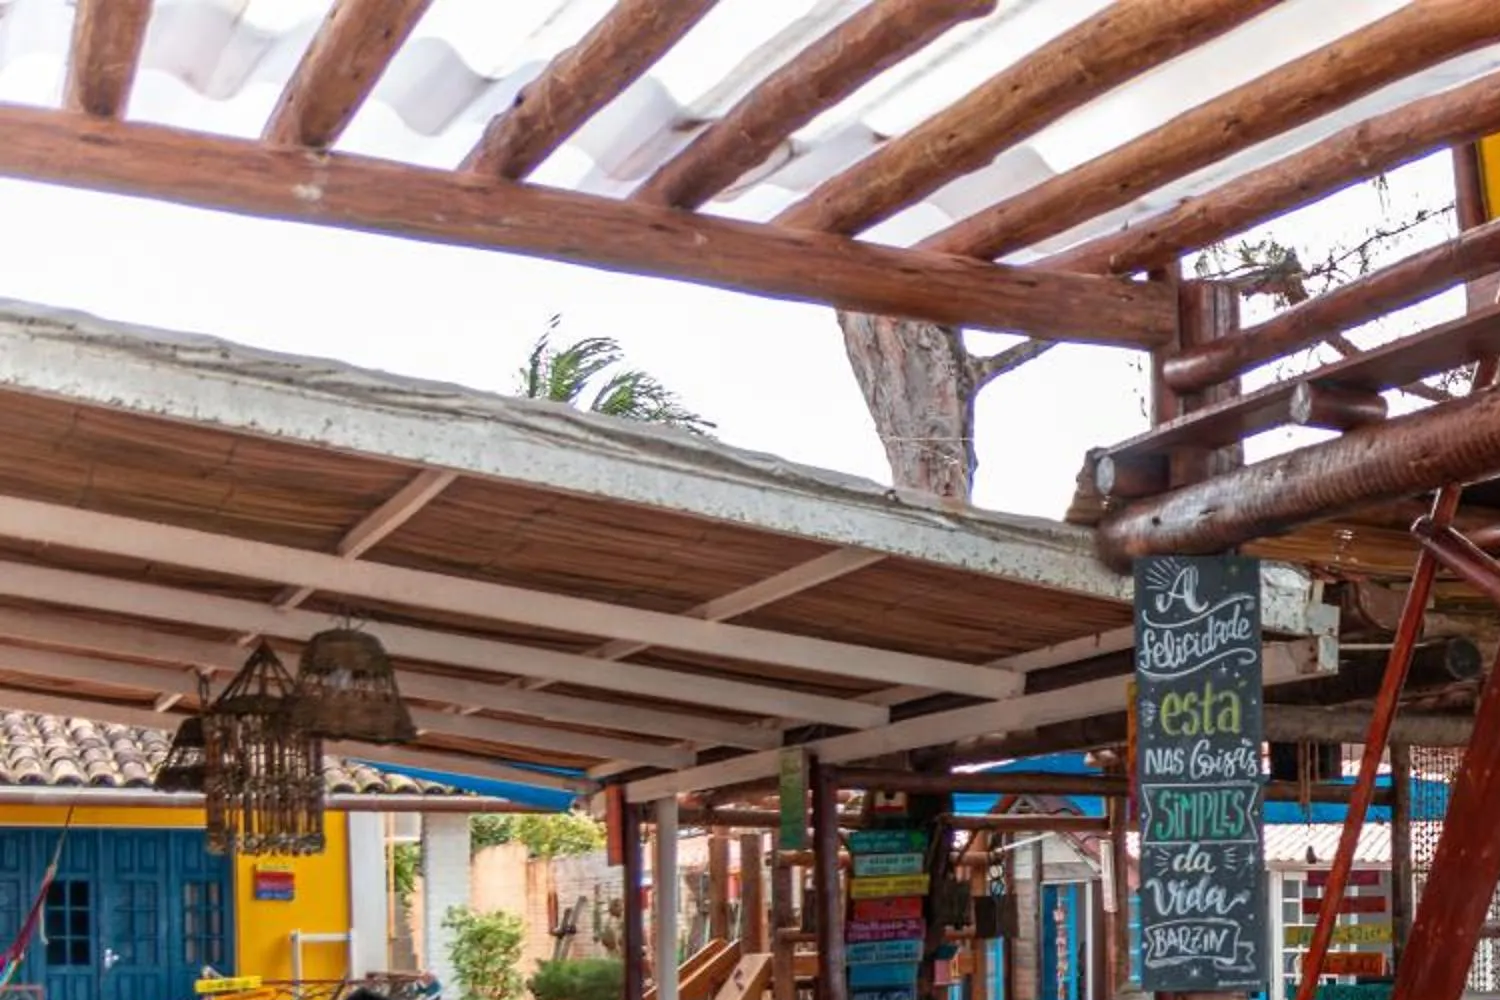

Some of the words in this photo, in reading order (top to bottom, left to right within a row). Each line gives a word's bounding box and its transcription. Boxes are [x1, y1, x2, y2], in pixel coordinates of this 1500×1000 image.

[1155, 565, 1209, 613] A
[1144, 748, 1186, 776] NAS
[1172, 843, 1217, 874] da
